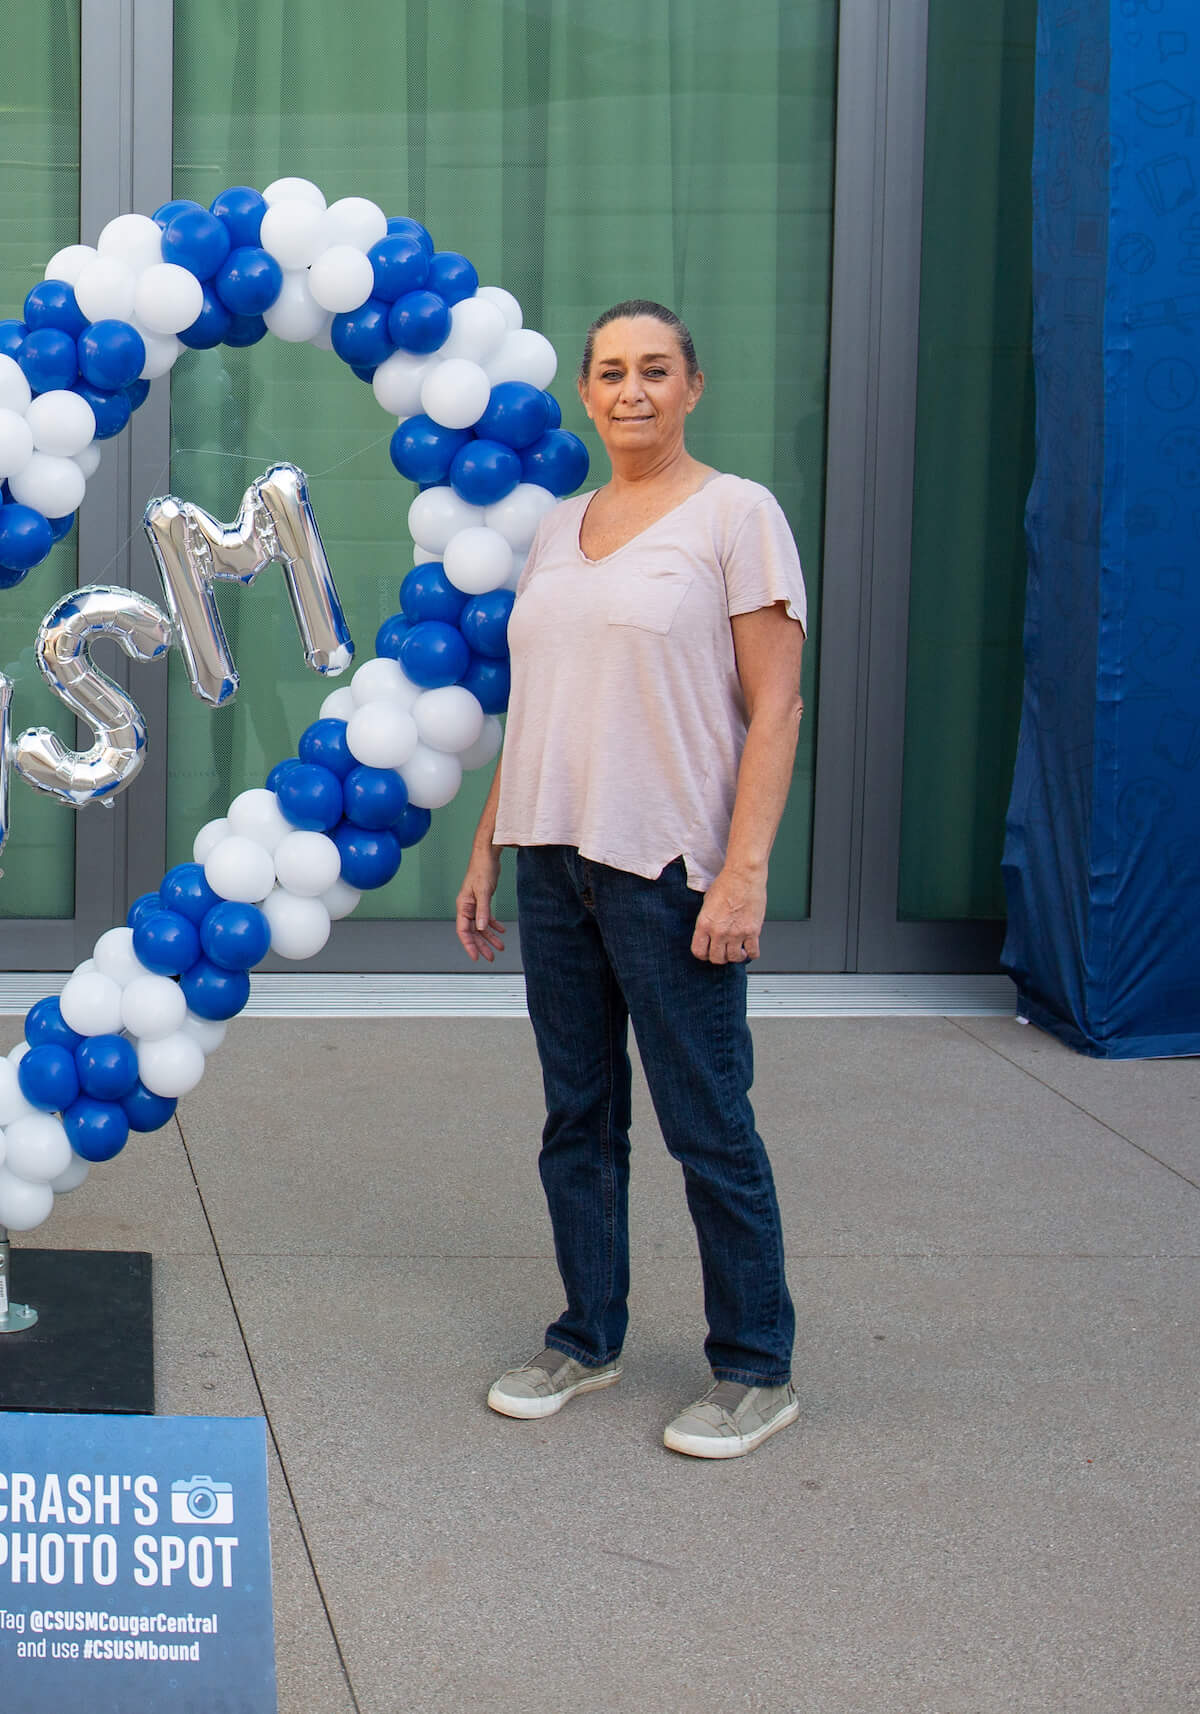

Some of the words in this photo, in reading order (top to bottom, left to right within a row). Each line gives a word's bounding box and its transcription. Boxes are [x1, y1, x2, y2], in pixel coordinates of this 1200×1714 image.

[133, 1534, 239, 1588] SPOT
[30, 1610, 218, 1634] @CSUSMCougarCentral
[17, 1639, 47, 1658] and
[52, 1644, 80, 1660] use
[83, 1639, 200, 1661] #CSUSMbound
